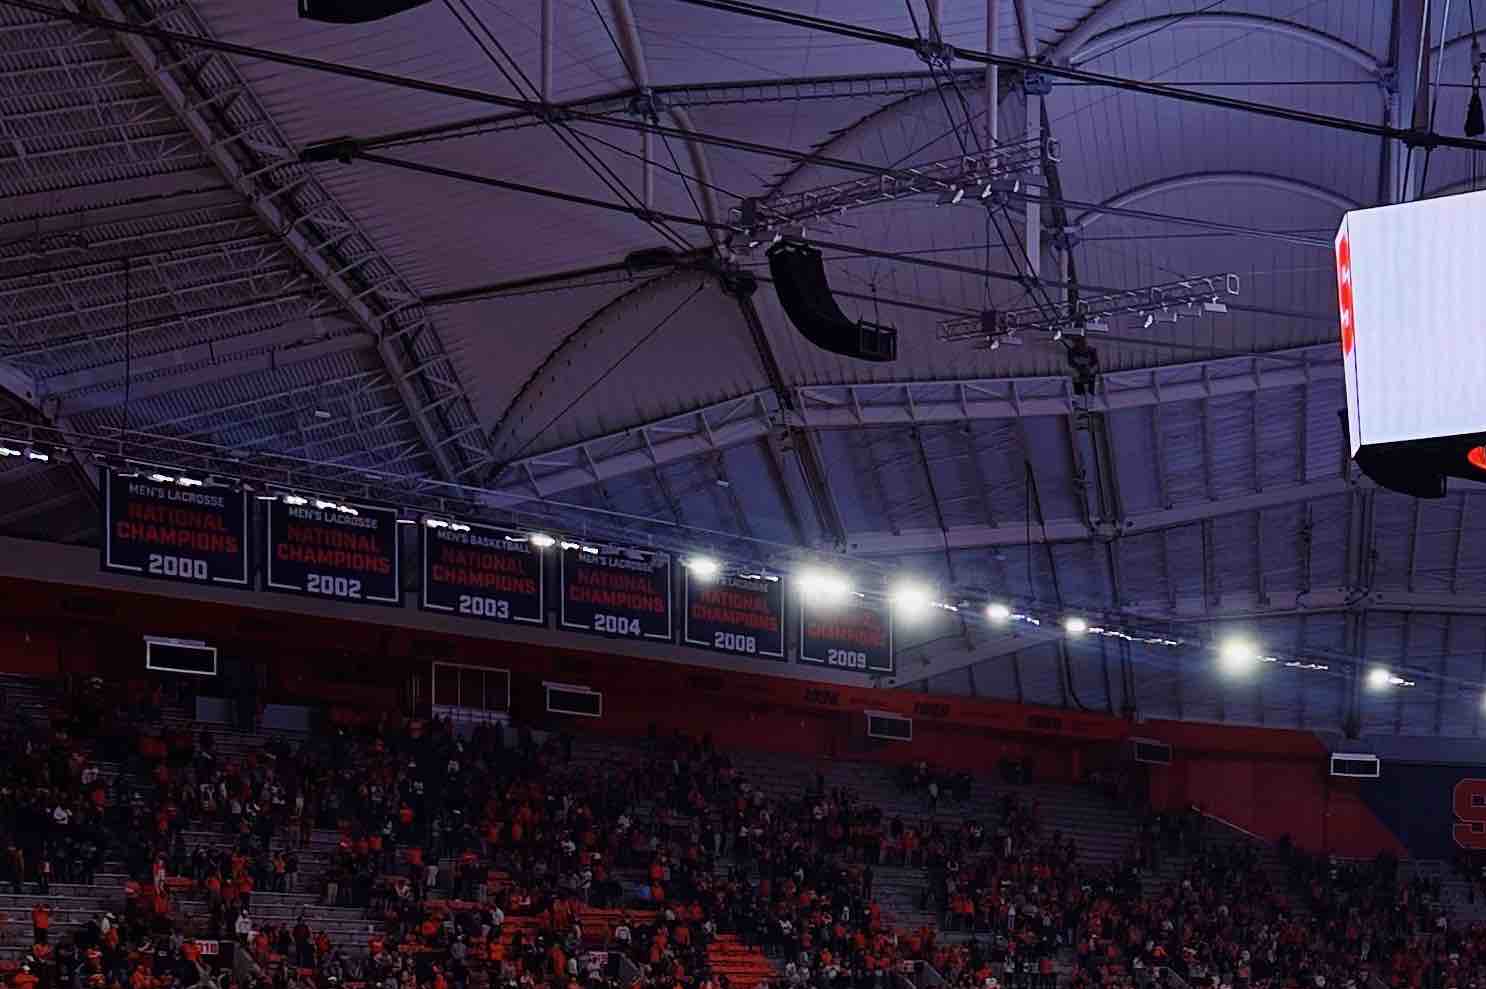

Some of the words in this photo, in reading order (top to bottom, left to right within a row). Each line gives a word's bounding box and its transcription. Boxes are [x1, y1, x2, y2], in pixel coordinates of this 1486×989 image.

[127, 502, 225, 530] NATIONAL
[115, 521, 239, 554] CHAMPIONS
[287, 523, 381, 552] NATIONAL
[148, 553, 208, 580] 2000
[276, 543, 391, 574] CHAMPIONS
[440, 546, 526, 575] NATIONAL
[306, 574, 362, 599] 2002
[432, 565, 536, 594] CHAMPIONS
[577, 567, 656, 595] NATIONAL
[459, 595, 509, 619] 2003
[568, 584, 665, 615] CHAMPIONS
[594, 614, 641, 636] 2004
[714, 631, 757, 654] 2008
[828, 649, 867, 669] 2009
